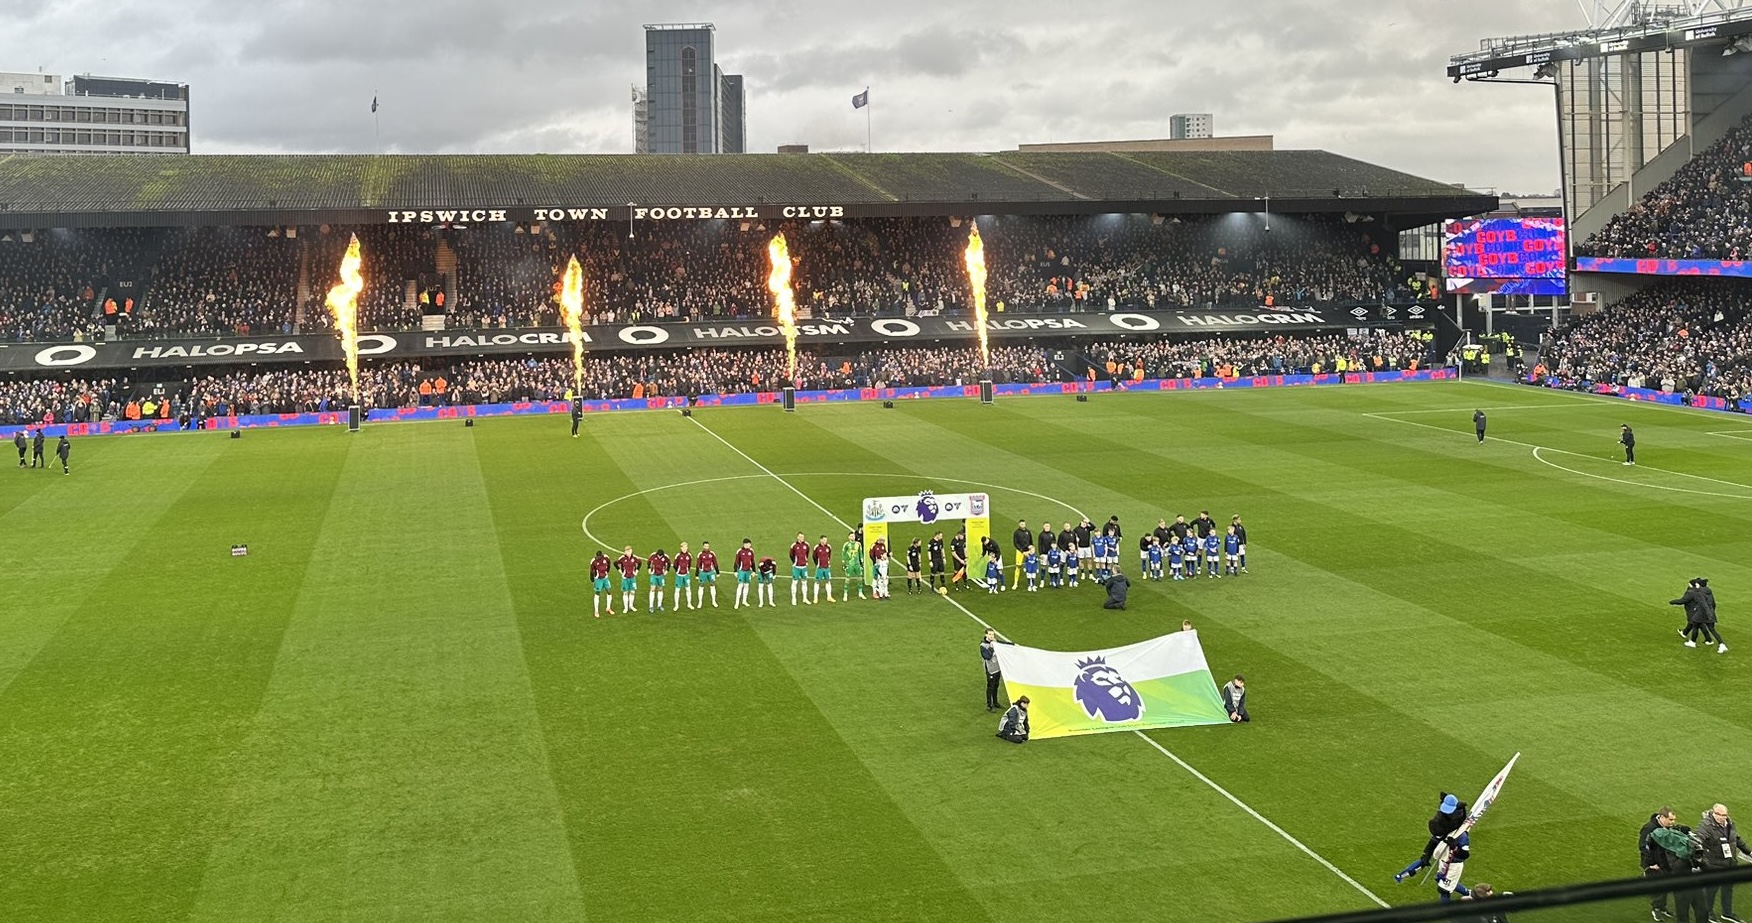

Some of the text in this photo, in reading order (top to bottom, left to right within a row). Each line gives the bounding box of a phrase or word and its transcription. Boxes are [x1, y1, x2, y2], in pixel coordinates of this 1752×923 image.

[388, 206, 844, 223] IPSWICH TOWN FOOTBALL CLUB
[1477, 229, 1517, 243] COYB
[1479, 252, 1519, 266] COYB
[1177, 312, 1326, 326] HALOCRM
[132, 341, 304, 359] HALOPSA
